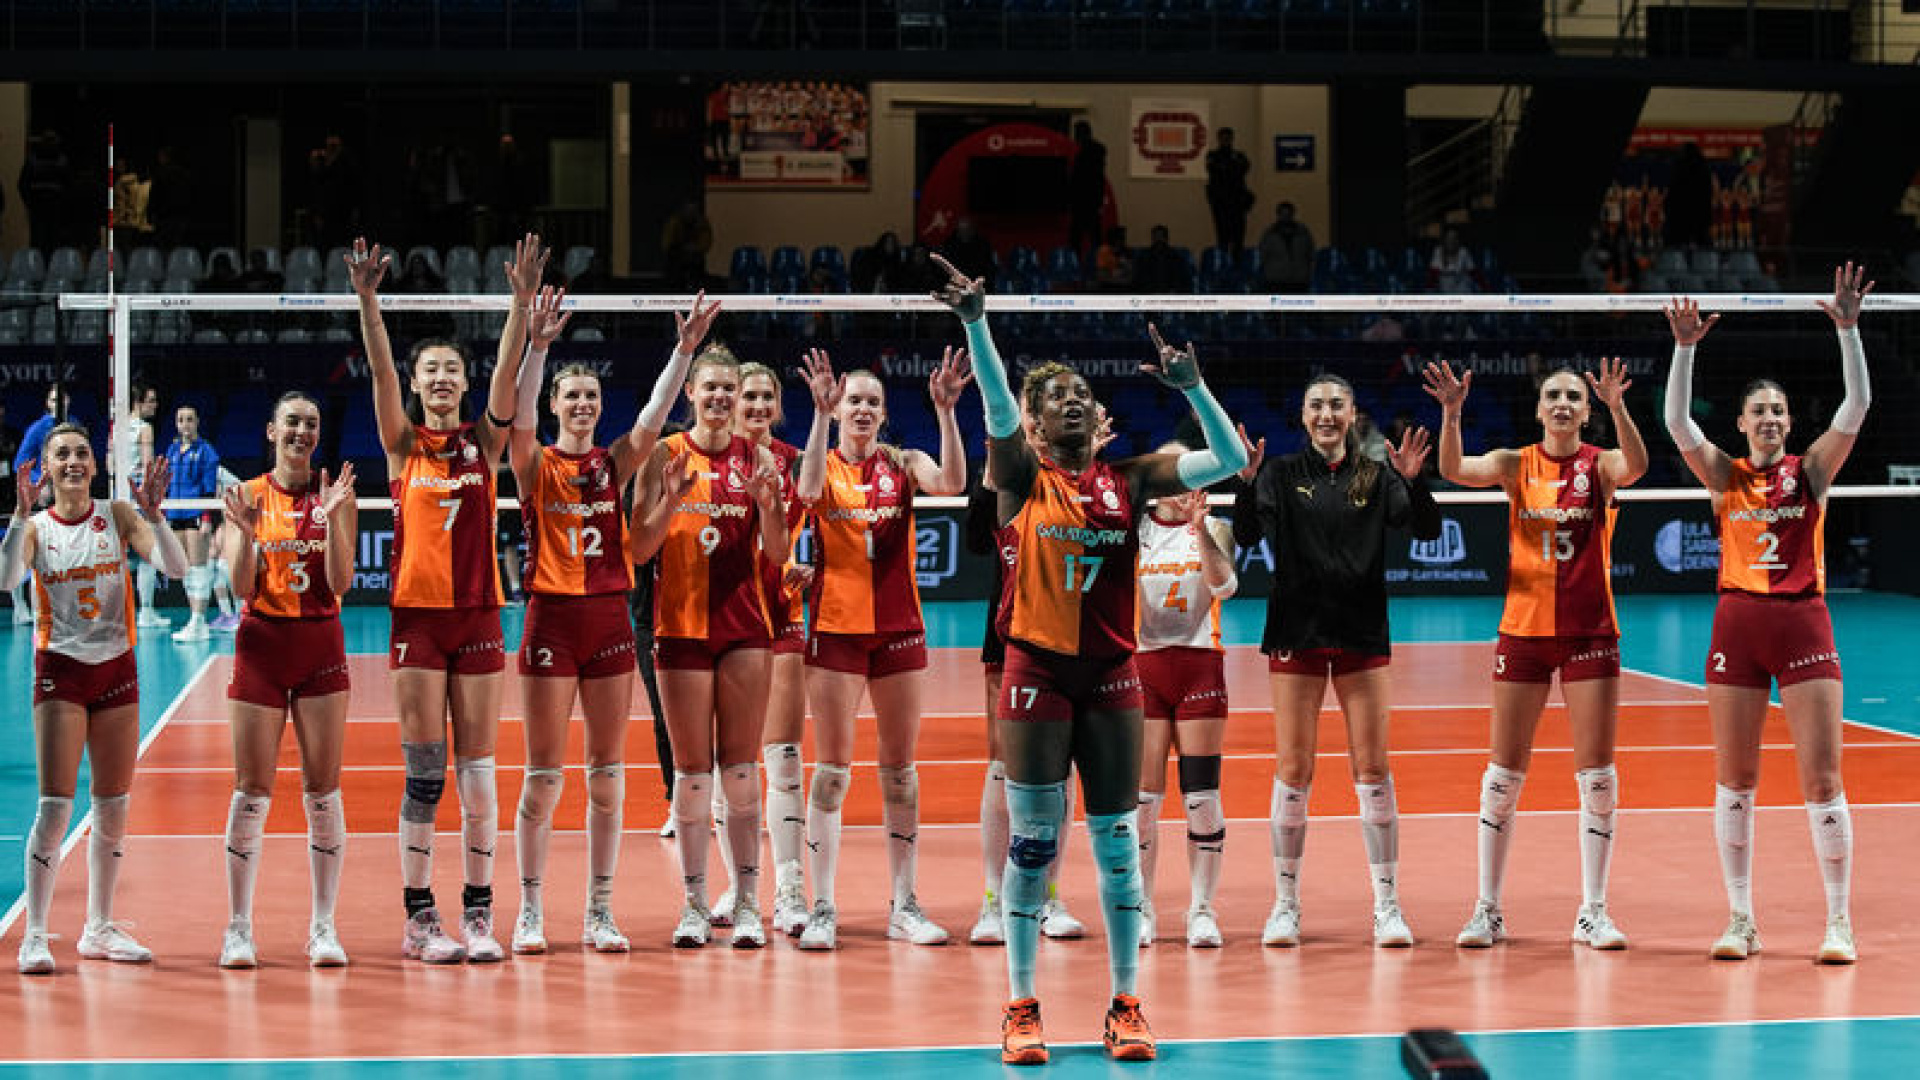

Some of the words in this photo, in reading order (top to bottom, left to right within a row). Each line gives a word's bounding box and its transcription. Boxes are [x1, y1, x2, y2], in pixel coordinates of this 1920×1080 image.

[438, 497, 464, 532] 7
[567, 526, 605, 558] 12
[698, 524, 723, 558] 9
[864, 528, 877, 560] 1
[1541, 529, 1576, 562] 13
[1754, 532, 1782, 562] 2
[287, 562, 311, 594] 3
[1063, 552, 1105, 594] 17
[77, 588, 101, 620] 5
[1162, 582, 1188, 614] 4
[395, 643, 409, 664] 7
[1712, 652, 1728, 673] 2
[1010, 686, 1039, 710] 17
